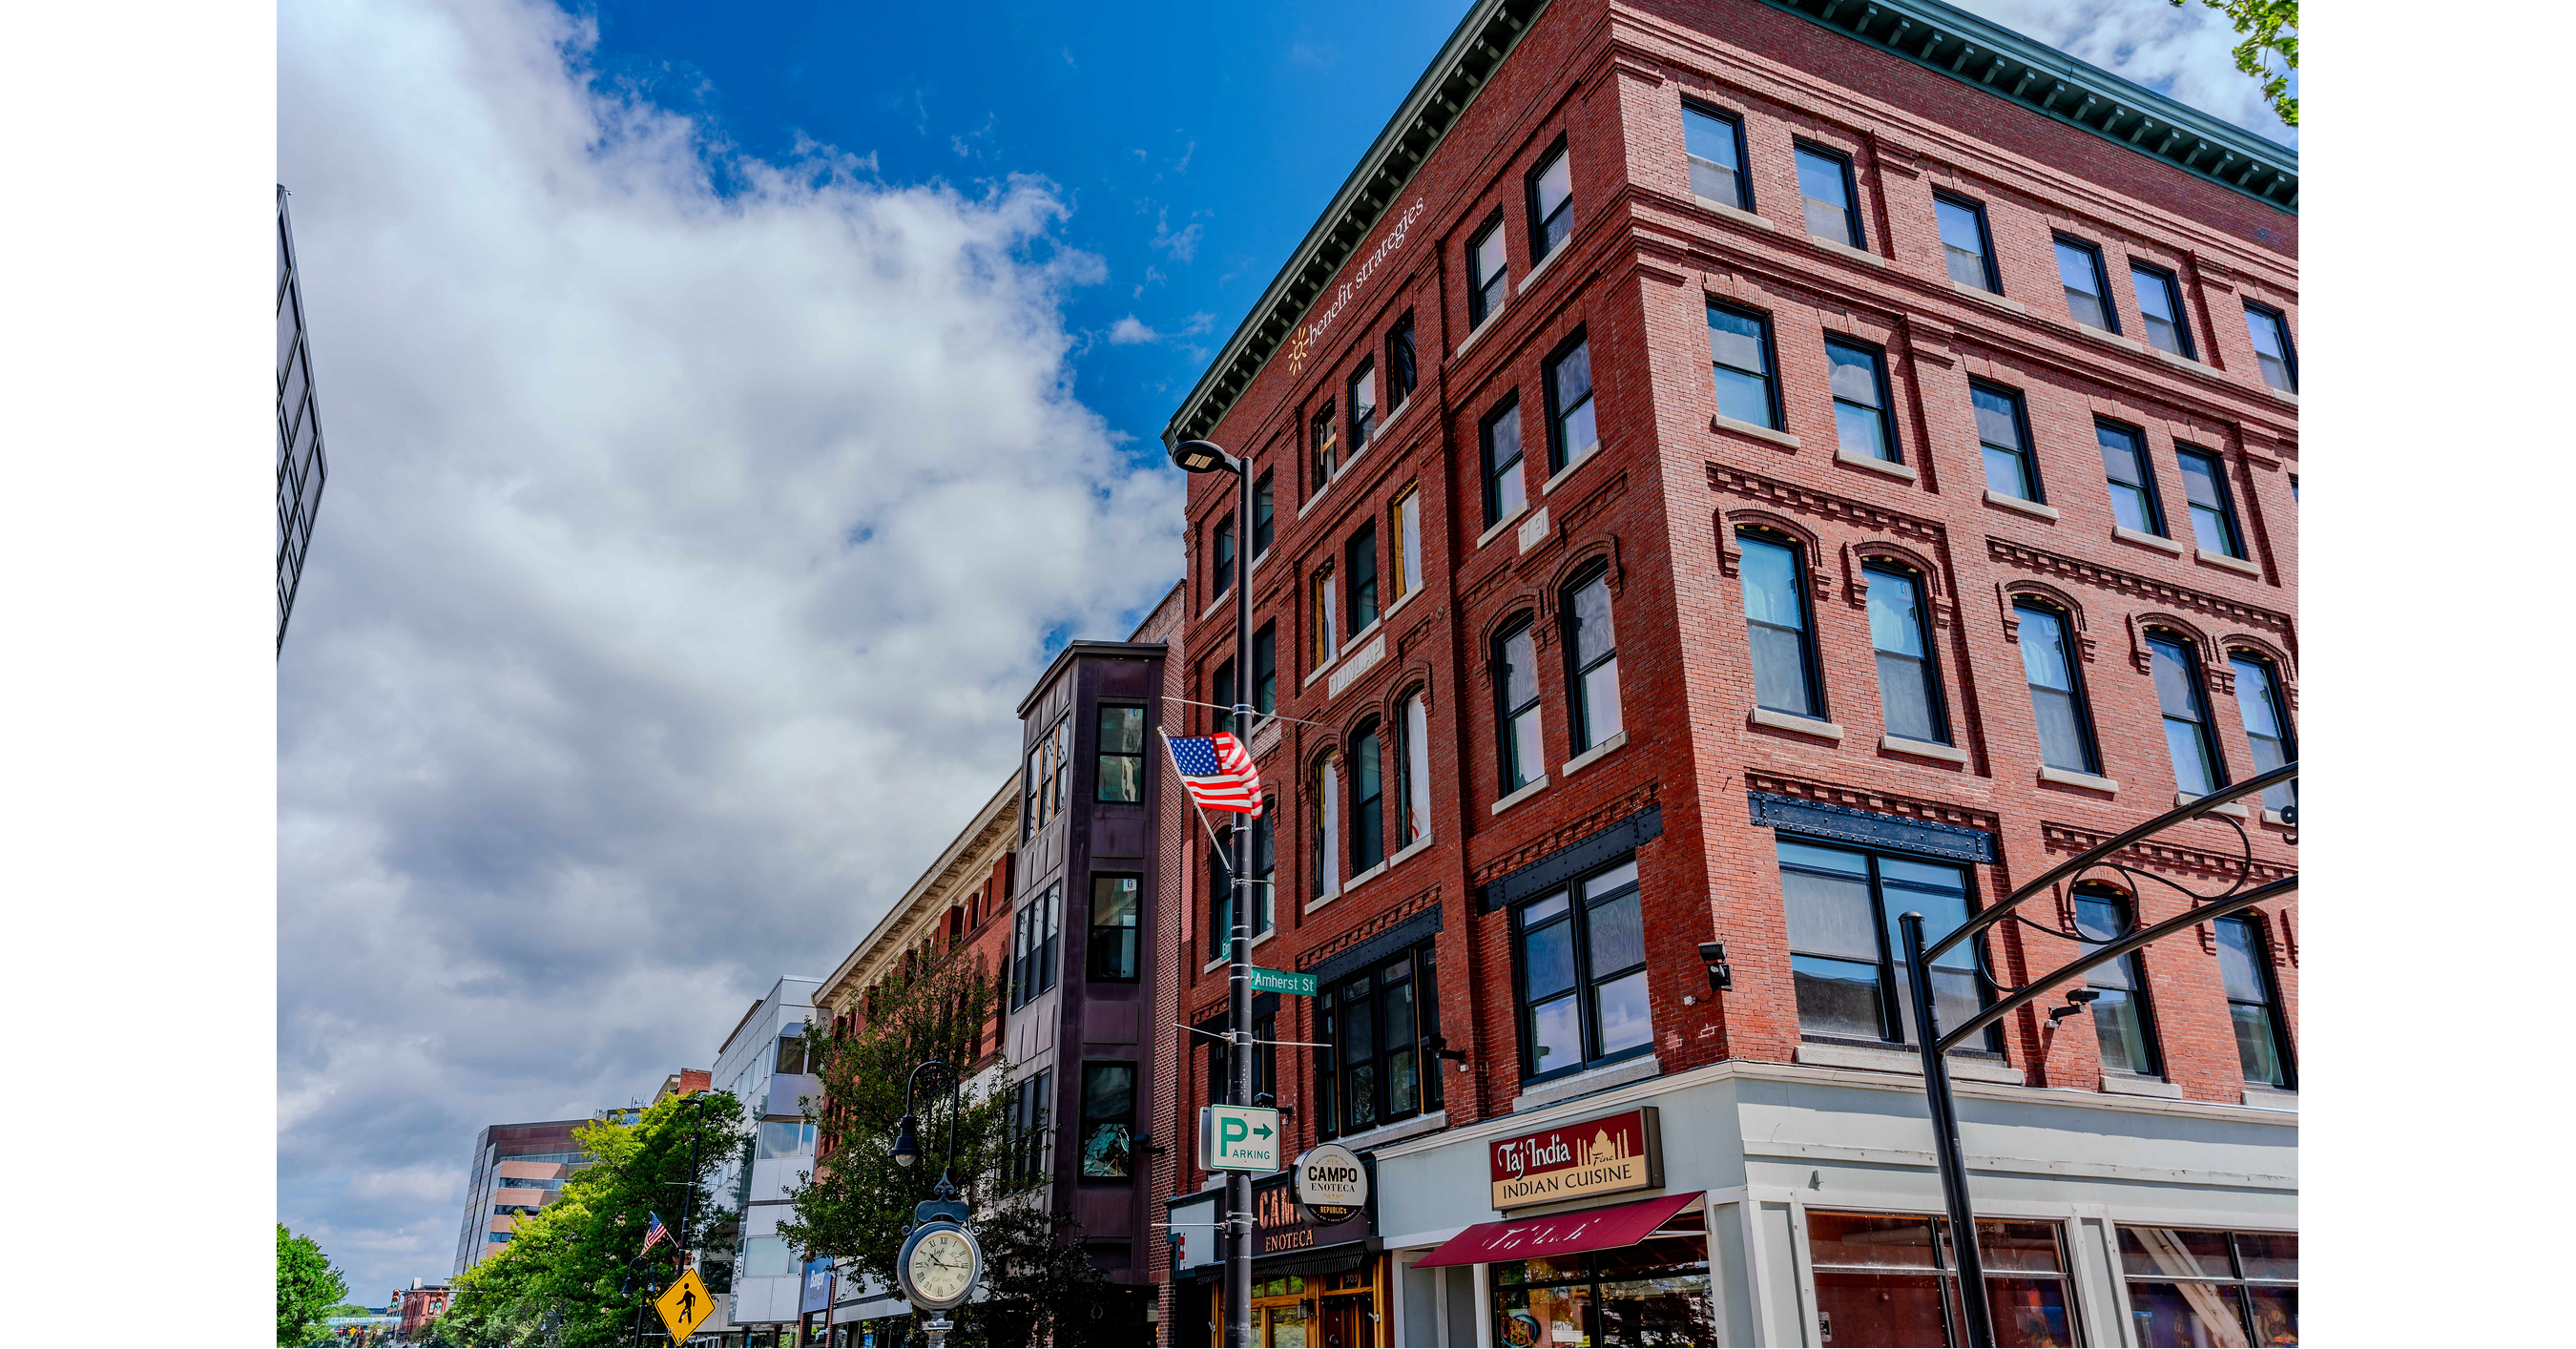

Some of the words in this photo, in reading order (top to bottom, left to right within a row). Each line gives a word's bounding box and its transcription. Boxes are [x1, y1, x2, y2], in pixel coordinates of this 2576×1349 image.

[1308, 280, 1354, 347] benefit
[1356, 197, 1424, 290] strategies
[1330, 638, 1382, 697] DUNLAP
[1255, 972, 1298, 990] Amherst
[1302, 978, 1314, 992] St
[1498, 1140, 1526, 1182] Taj
[1526, 1133, 1571, 1168] India
[1592, 1152, 1615, 1167] Fine
[1308, 1166, 1358, 1183] CAMPO
[1311, 1183, 1355, 1193] ENOTECA
[1503, 1176, 1559, 1199] INDIAN
[1565, 1164, 1632, 1189] CUISINE
[1259, 1187, 1301, 1230] CAM
[1265, 1229, 1314, 1253] ENOTECA
